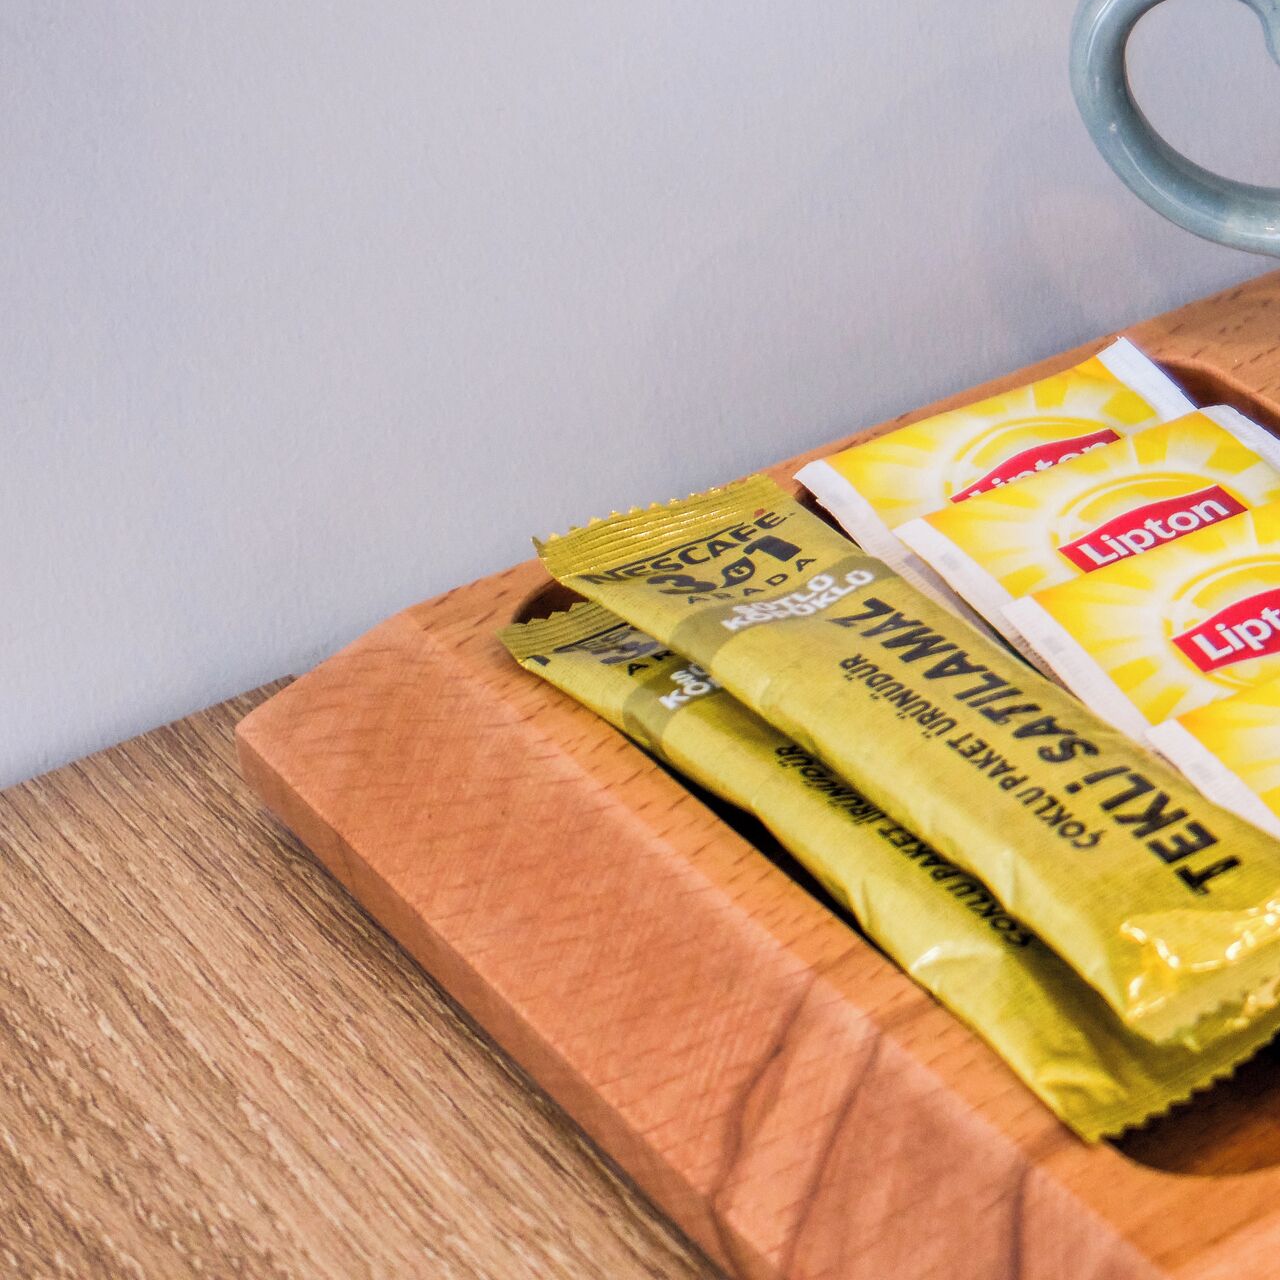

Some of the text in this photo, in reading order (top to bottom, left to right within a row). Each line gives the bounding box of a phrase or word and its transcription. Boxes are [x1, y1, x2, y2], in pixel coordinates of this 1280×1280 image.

[1075, 495, 1230, 566] Lipton
[827, 596, 1243, 897] TEKLİ SATILAMAZ
[945, 731, 1031, 791] PAKET
